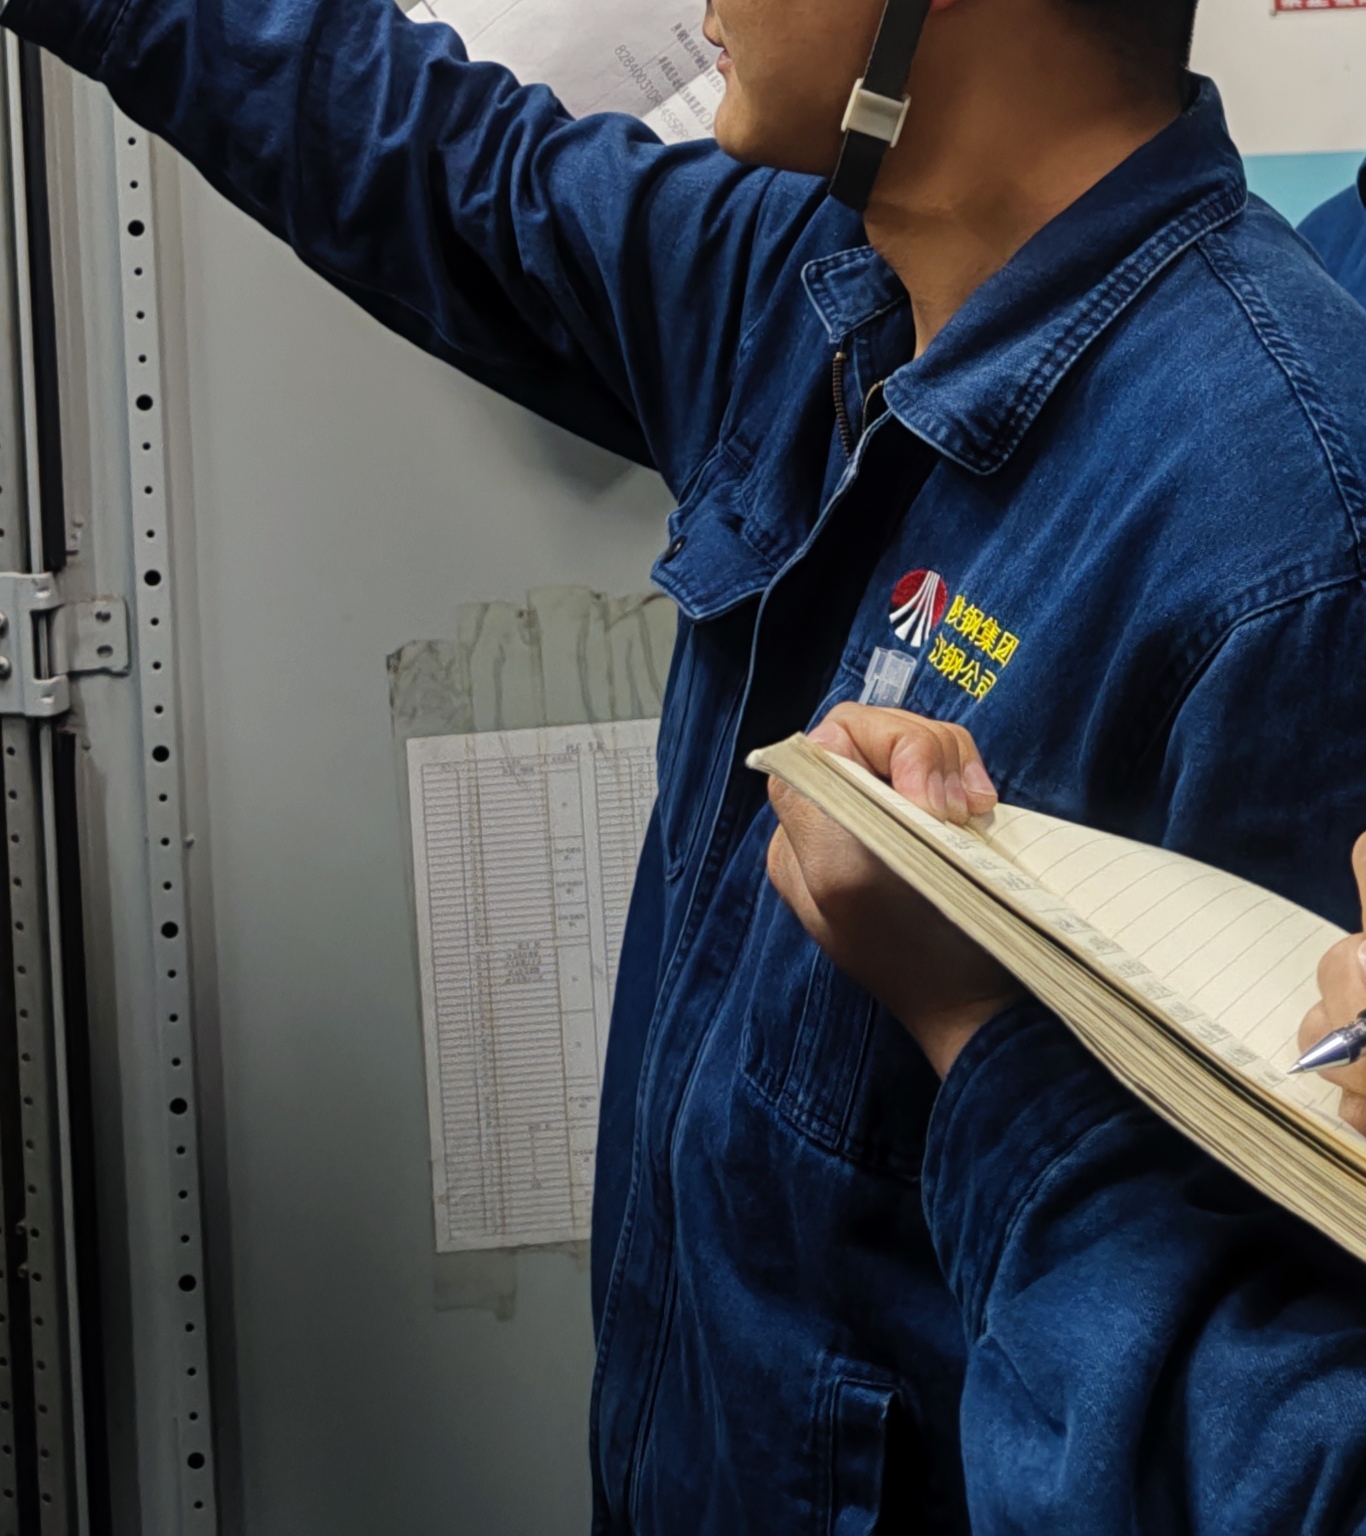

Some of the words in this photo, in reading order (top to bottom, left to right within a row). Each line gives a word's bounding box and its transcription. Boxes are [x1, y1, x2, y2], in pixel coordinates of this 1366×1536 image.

[928, 630, 997, 703] 汉钢公司
[945, 594, 1020, 668] 陕钢集团
